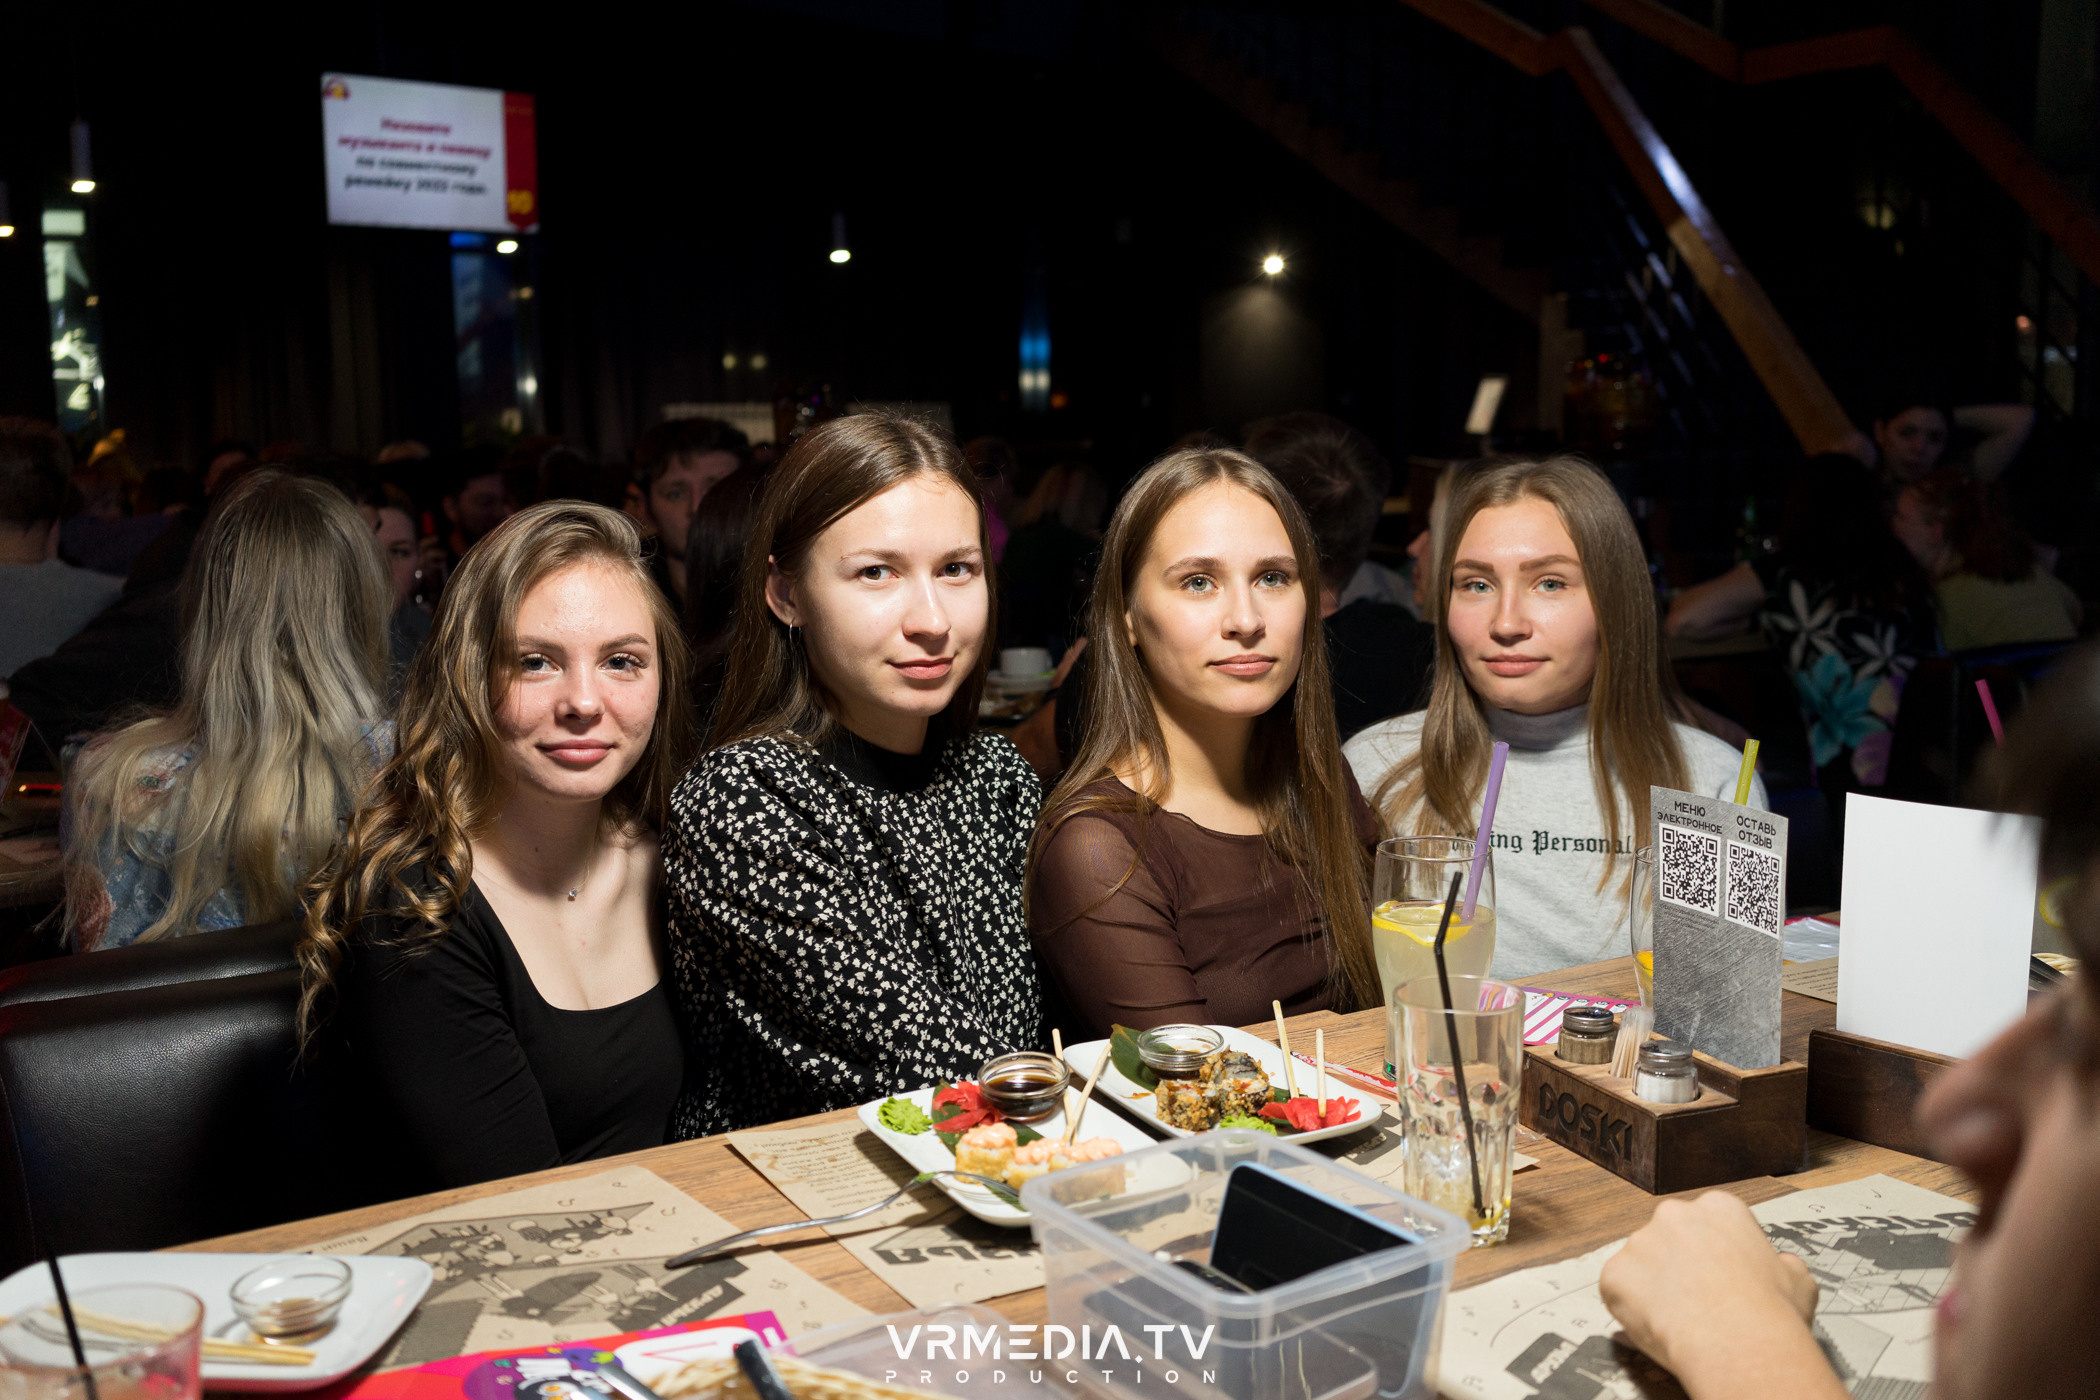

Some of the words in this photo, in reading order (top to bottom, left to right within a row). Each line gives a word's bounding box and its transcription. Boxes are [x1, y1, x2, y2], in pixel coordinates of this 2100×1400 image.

[1674, 801, 1706, 817] МЕНЮ
[1657, 811, 1723, 834] ЭЛЕКТРОННОЕ
[1736, 815, 1777, 836] ОСТАВЬ
[1532, 829, 1633, 855] Personal
[1738, 830, 1773, 849] ОТЗЫВ
[1538, 1082, 1633, 1161] DOSKI
